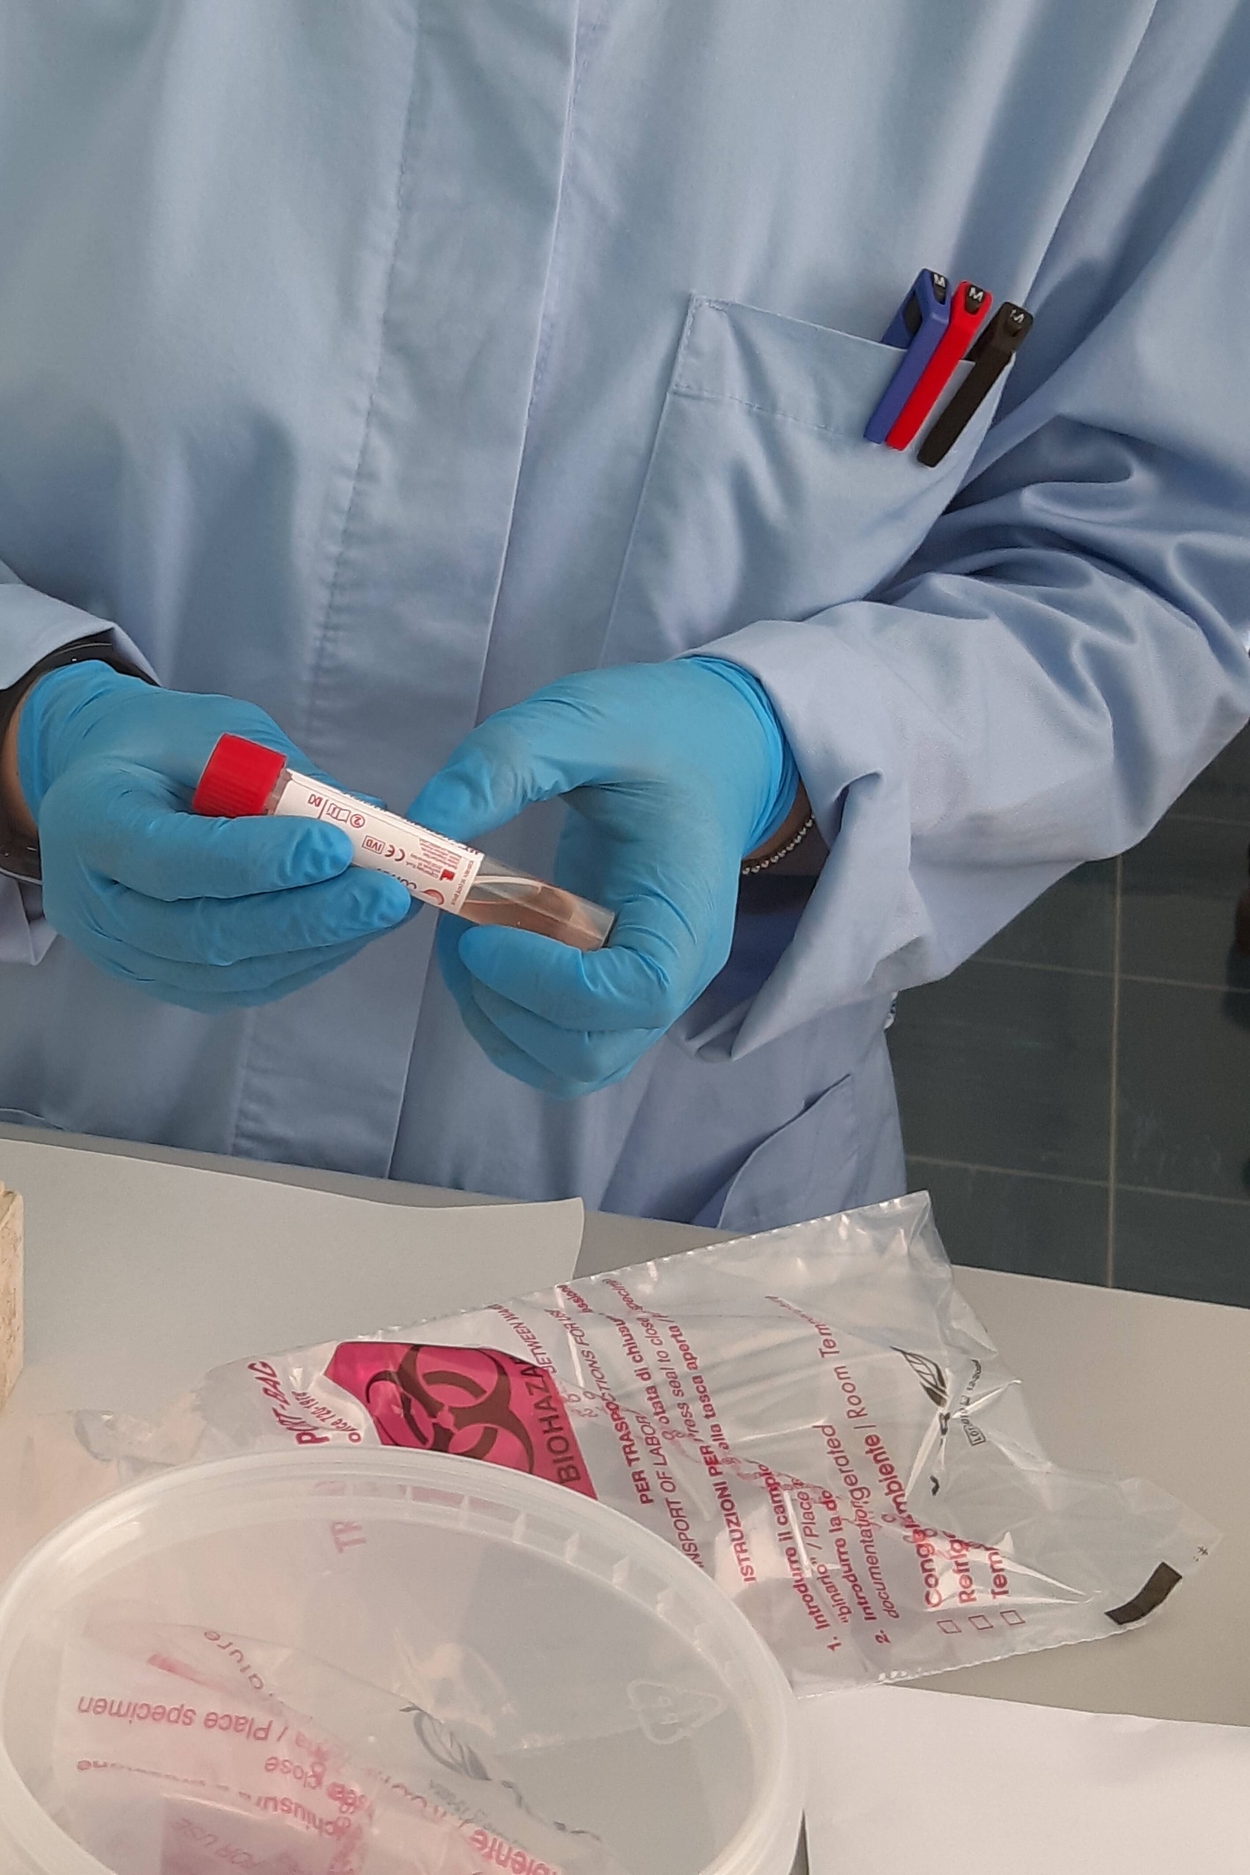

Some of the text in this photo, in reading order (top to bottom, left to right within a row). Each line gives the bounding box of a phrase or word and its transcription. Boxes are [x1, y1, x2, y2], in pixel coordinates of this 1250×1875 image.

[968, 286, 985, 303] M
[363, 836, 384, 853] IVD
[656, 1350, 672, 1363] to
[667, 1325, 699, 1372] aperta
[634, 1367, 653, 1383] di
[659, 1367, 685, 1399] seal
[692, 1374, 717, 1420] tasca
[834, 1365, 868, 1419] Room
[644, 1384, 671, 1425] otata
[635, 1414, 669, 1466] LABOR
[631, 1469, 654, 1504] PER
[656, 1470, 678, 1494] OF
[813, 1424, 872, 1507] gerated
[864, 1434, 910, 1513] mbiente
[699, 1443, 757, 1582] ISTRUZIONI PER
[758, 1463, 790, 1526] campio
[796, 1490, 821, 1539] Place
[776, 1530, 794, 1543] il
[827, 1515, 844, 1534] la
[785, 1547, 831, 1631] Introdurre
[833, 1537, 878, 1622] Introdurre
[949, 1540, 978, 1605] Refrig
[987, 1550, 1011, 1600] Tem
[203, 1630, 265, 1691] ature
[77, 1696, 197, 1727] specimen
[203, 1711, 274, 1742] Place
